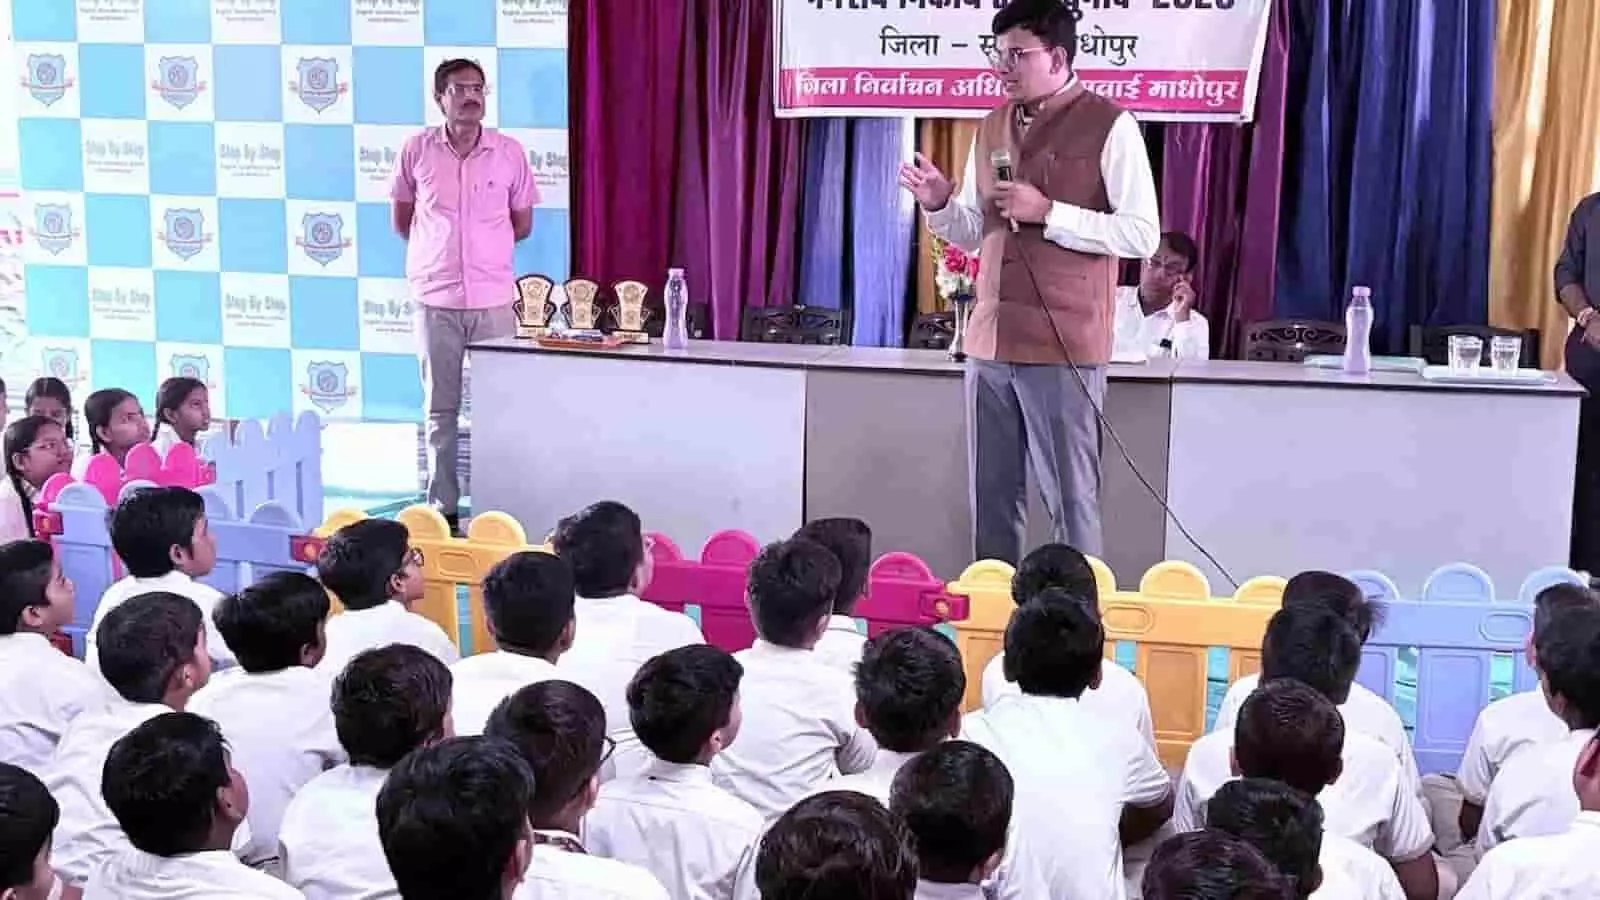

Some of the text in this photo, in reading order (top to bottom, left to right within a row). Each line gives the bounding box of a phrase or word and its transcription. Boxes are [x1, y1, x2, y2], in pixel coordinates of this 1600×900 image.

[879, 24, 941, 57] जिला
[853, 71, 945, 97] निर्वाचन
[1147, 73, 1240, 107] माधोपुर
